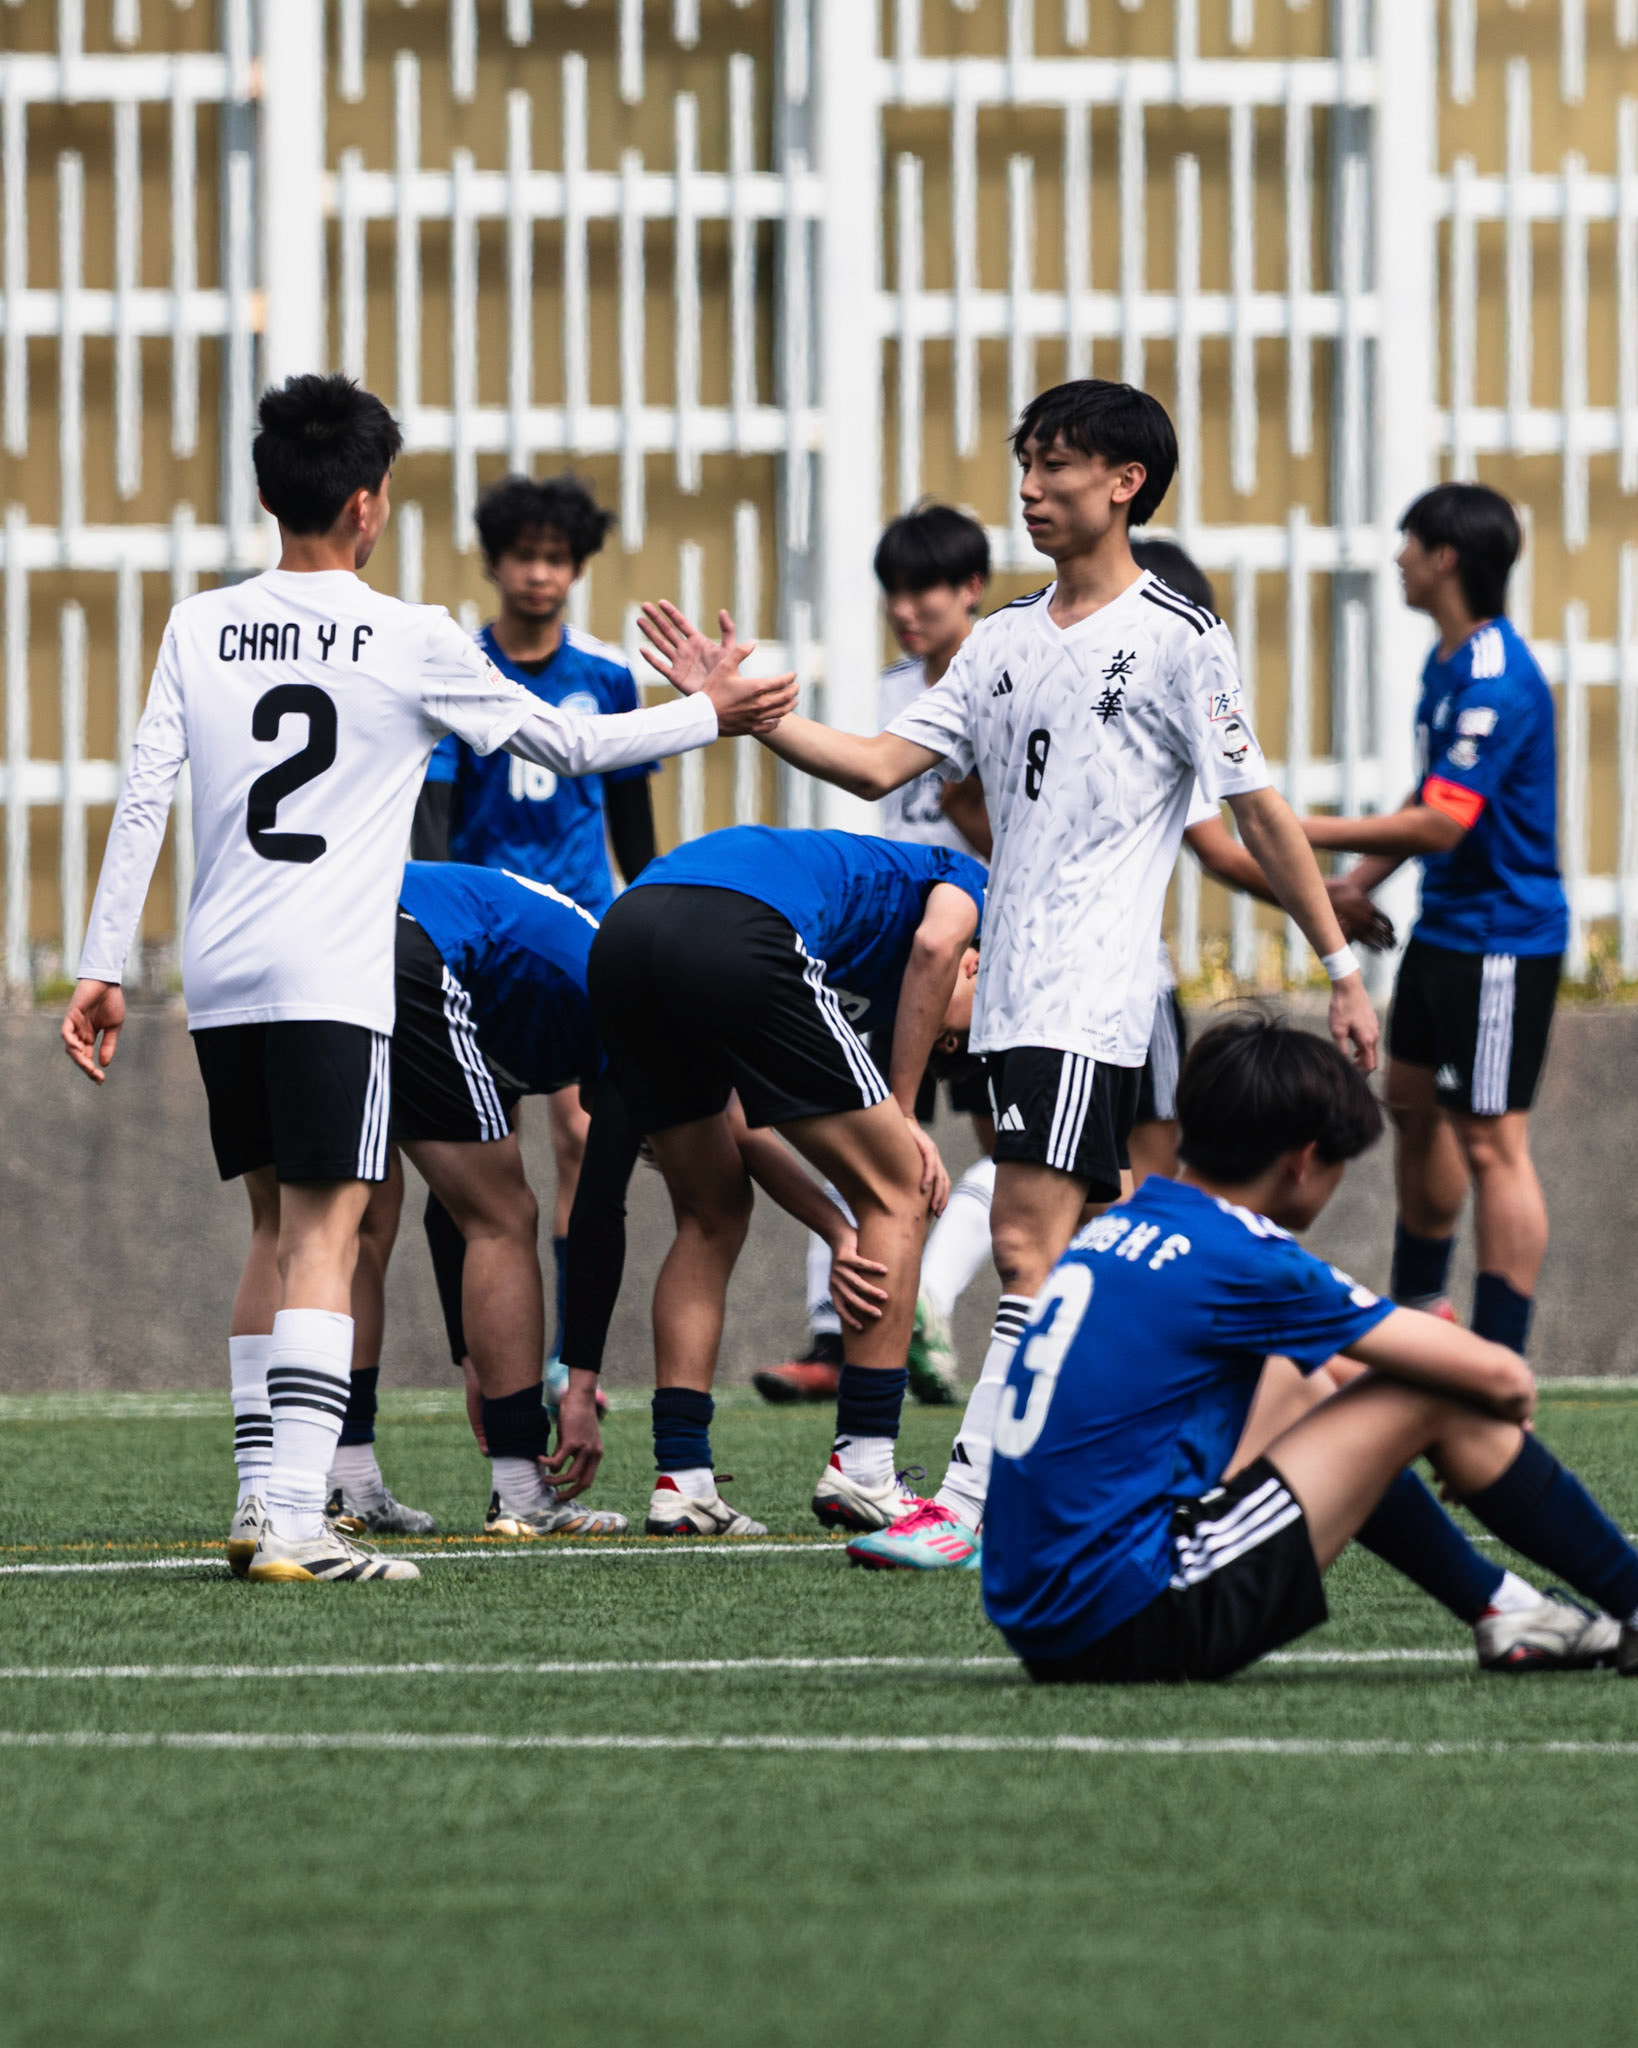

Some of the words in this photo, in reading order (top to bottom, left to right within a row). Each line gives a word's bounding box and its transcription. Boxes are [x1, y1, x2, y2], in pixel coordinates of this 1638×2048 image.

[219, 623, 300, 661] CHAN
[318, 624, 336, 661] Y
[352, 625, 373, 662] F
[1090, 649, 1137, 725] 英華
[247, 684, 337, 863] 2
[1025, 729, 1051, 801] 8
[995, 1263, 1093, 1459] 3
